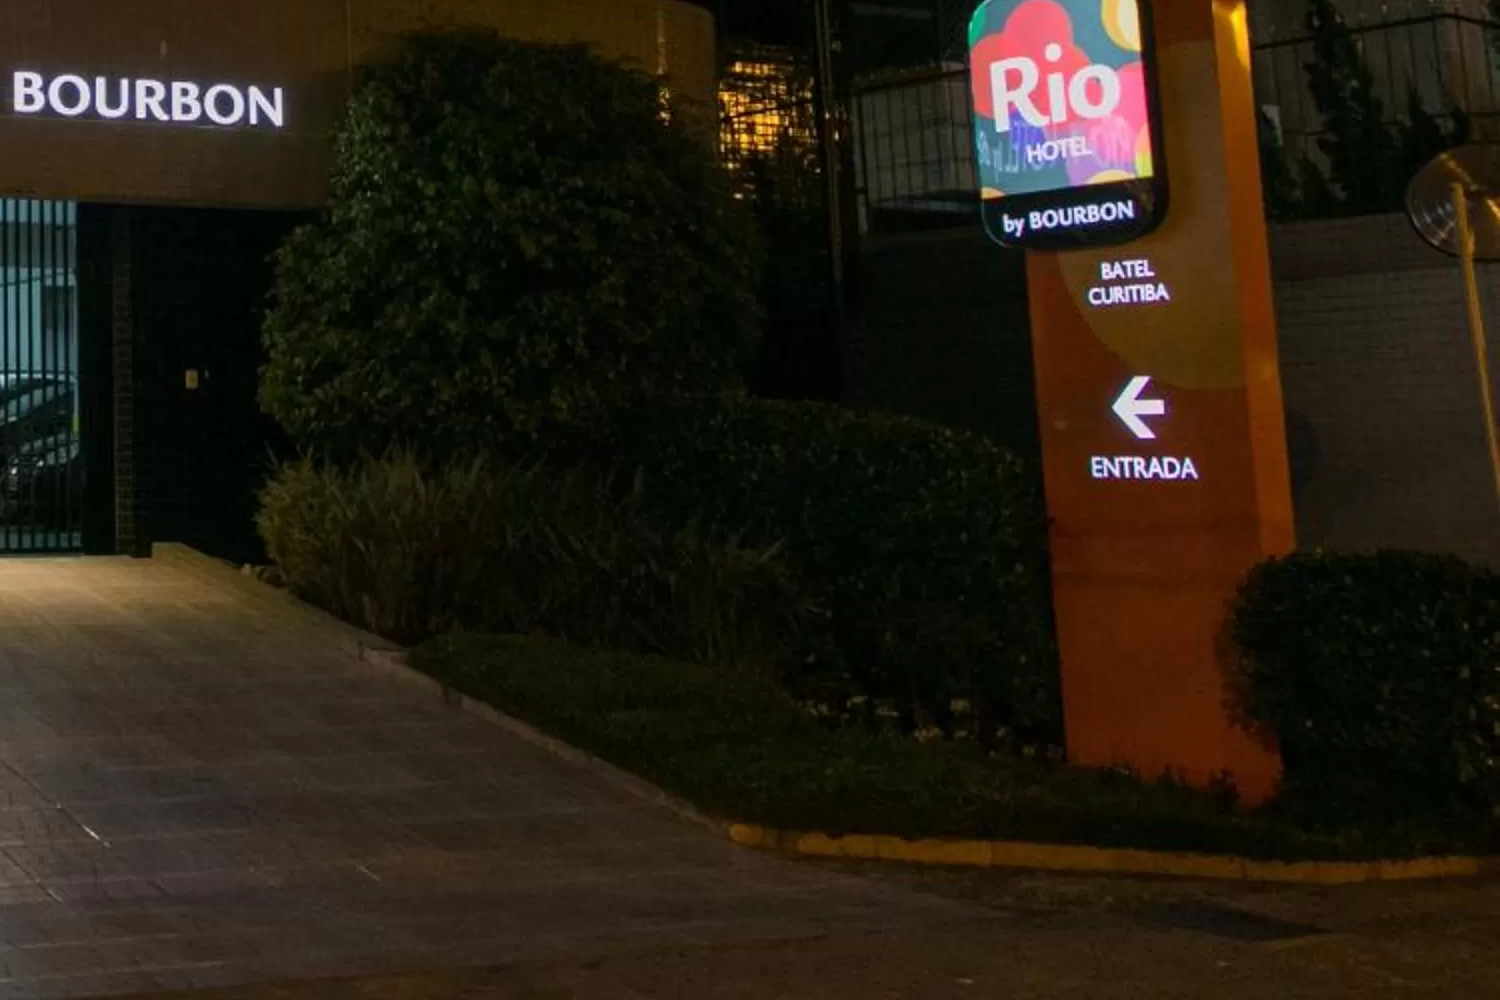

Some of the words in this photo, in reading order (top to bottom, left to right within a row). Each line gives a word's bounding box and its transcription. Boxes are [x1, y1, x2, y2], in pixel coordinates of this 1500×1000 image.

[13, 70, 284, 128] BOURBON
[989, 42, 1121, 133] Rio
[1026, 136, 1093, 163] HOTEL
[1002, 212, 1026, 238] by
[1028, 199, 1135, 230] BOURBON
[1100, 258, 1155, 281] BATEL
[1088, 282, 1171, 306] CURITIBA
[1090, 455, 1199, 480] ENTRADA
